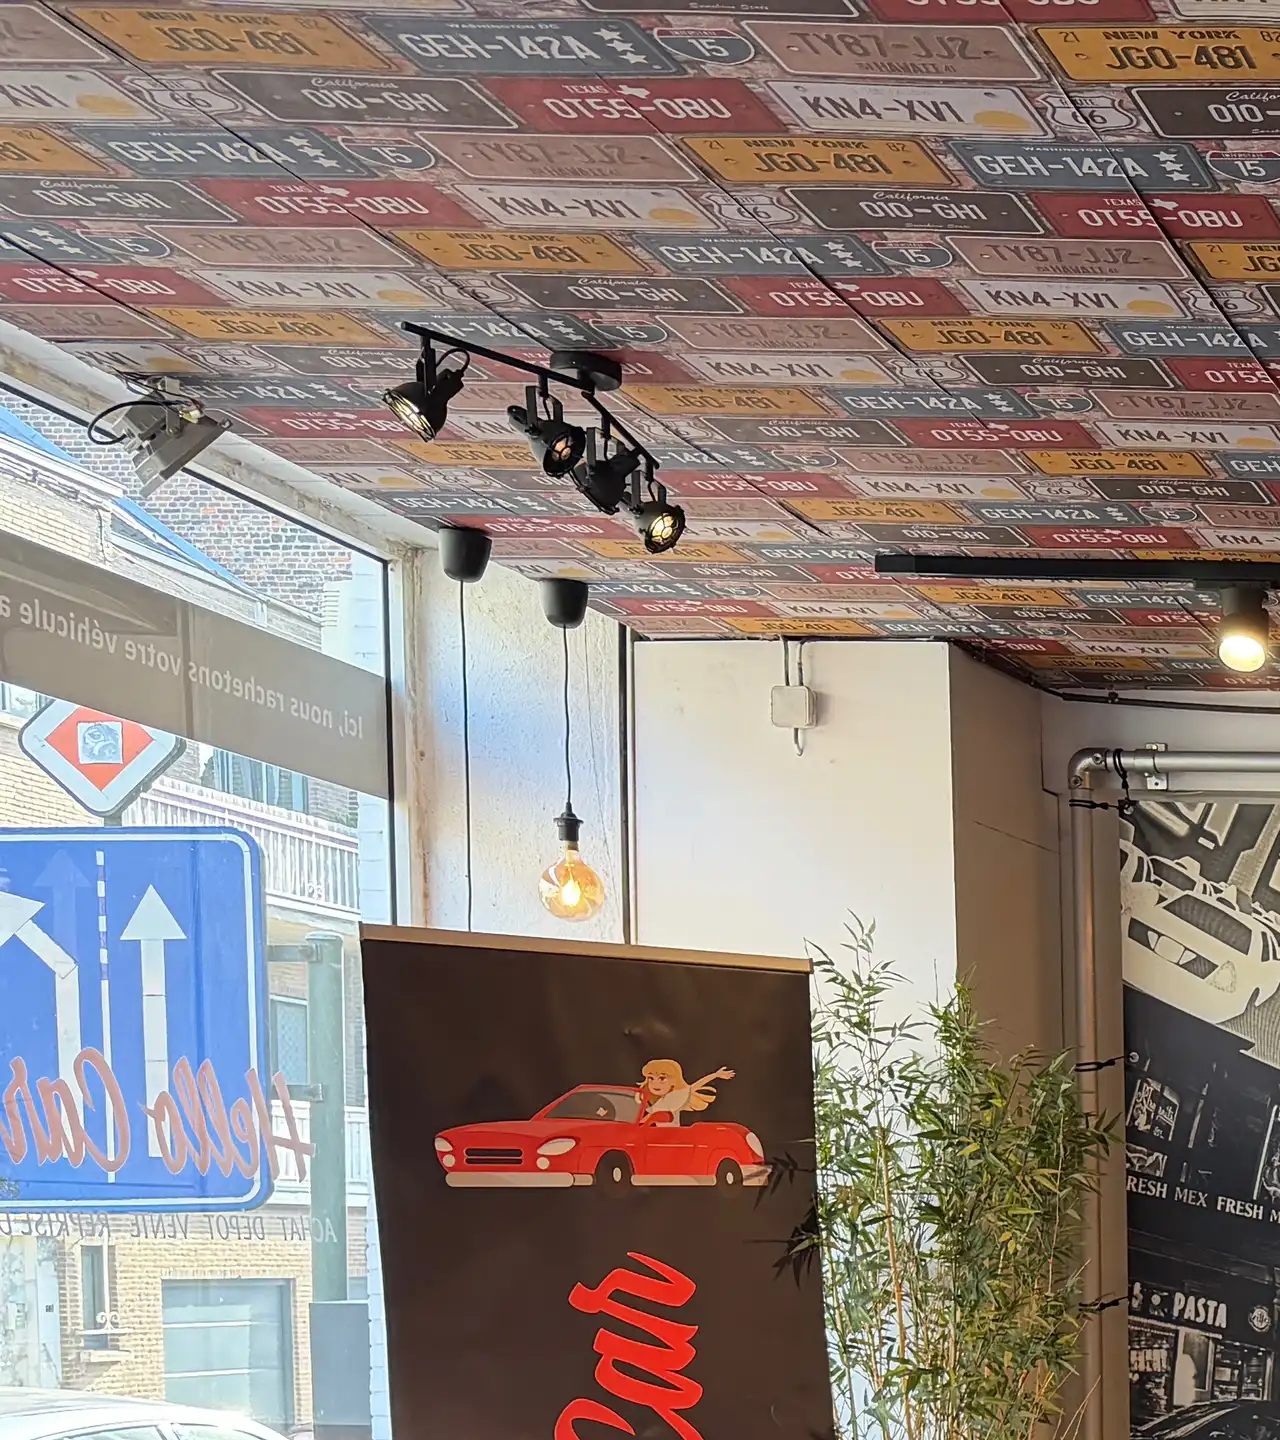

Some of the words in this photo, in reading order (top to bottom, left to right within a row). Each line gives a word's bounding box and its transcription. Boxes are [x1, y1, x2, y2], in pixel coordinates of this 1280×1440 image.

[398, 33, 602, 60] GEH-142A
[687, 38, 730, 57] 15
[1102, 30, 1159, 40] NEW
[1169, 30, 1241, 40] YORK
[1104, 45, 1258, 71] JGO-481
[1126, 1174, 1168, 1199] RESH
[1174, 1187, 1209, 1208] MEX
[1216, 1196, 1264, 1220] FRESH
[1172, 1292, 1228, 1329] PASTA
